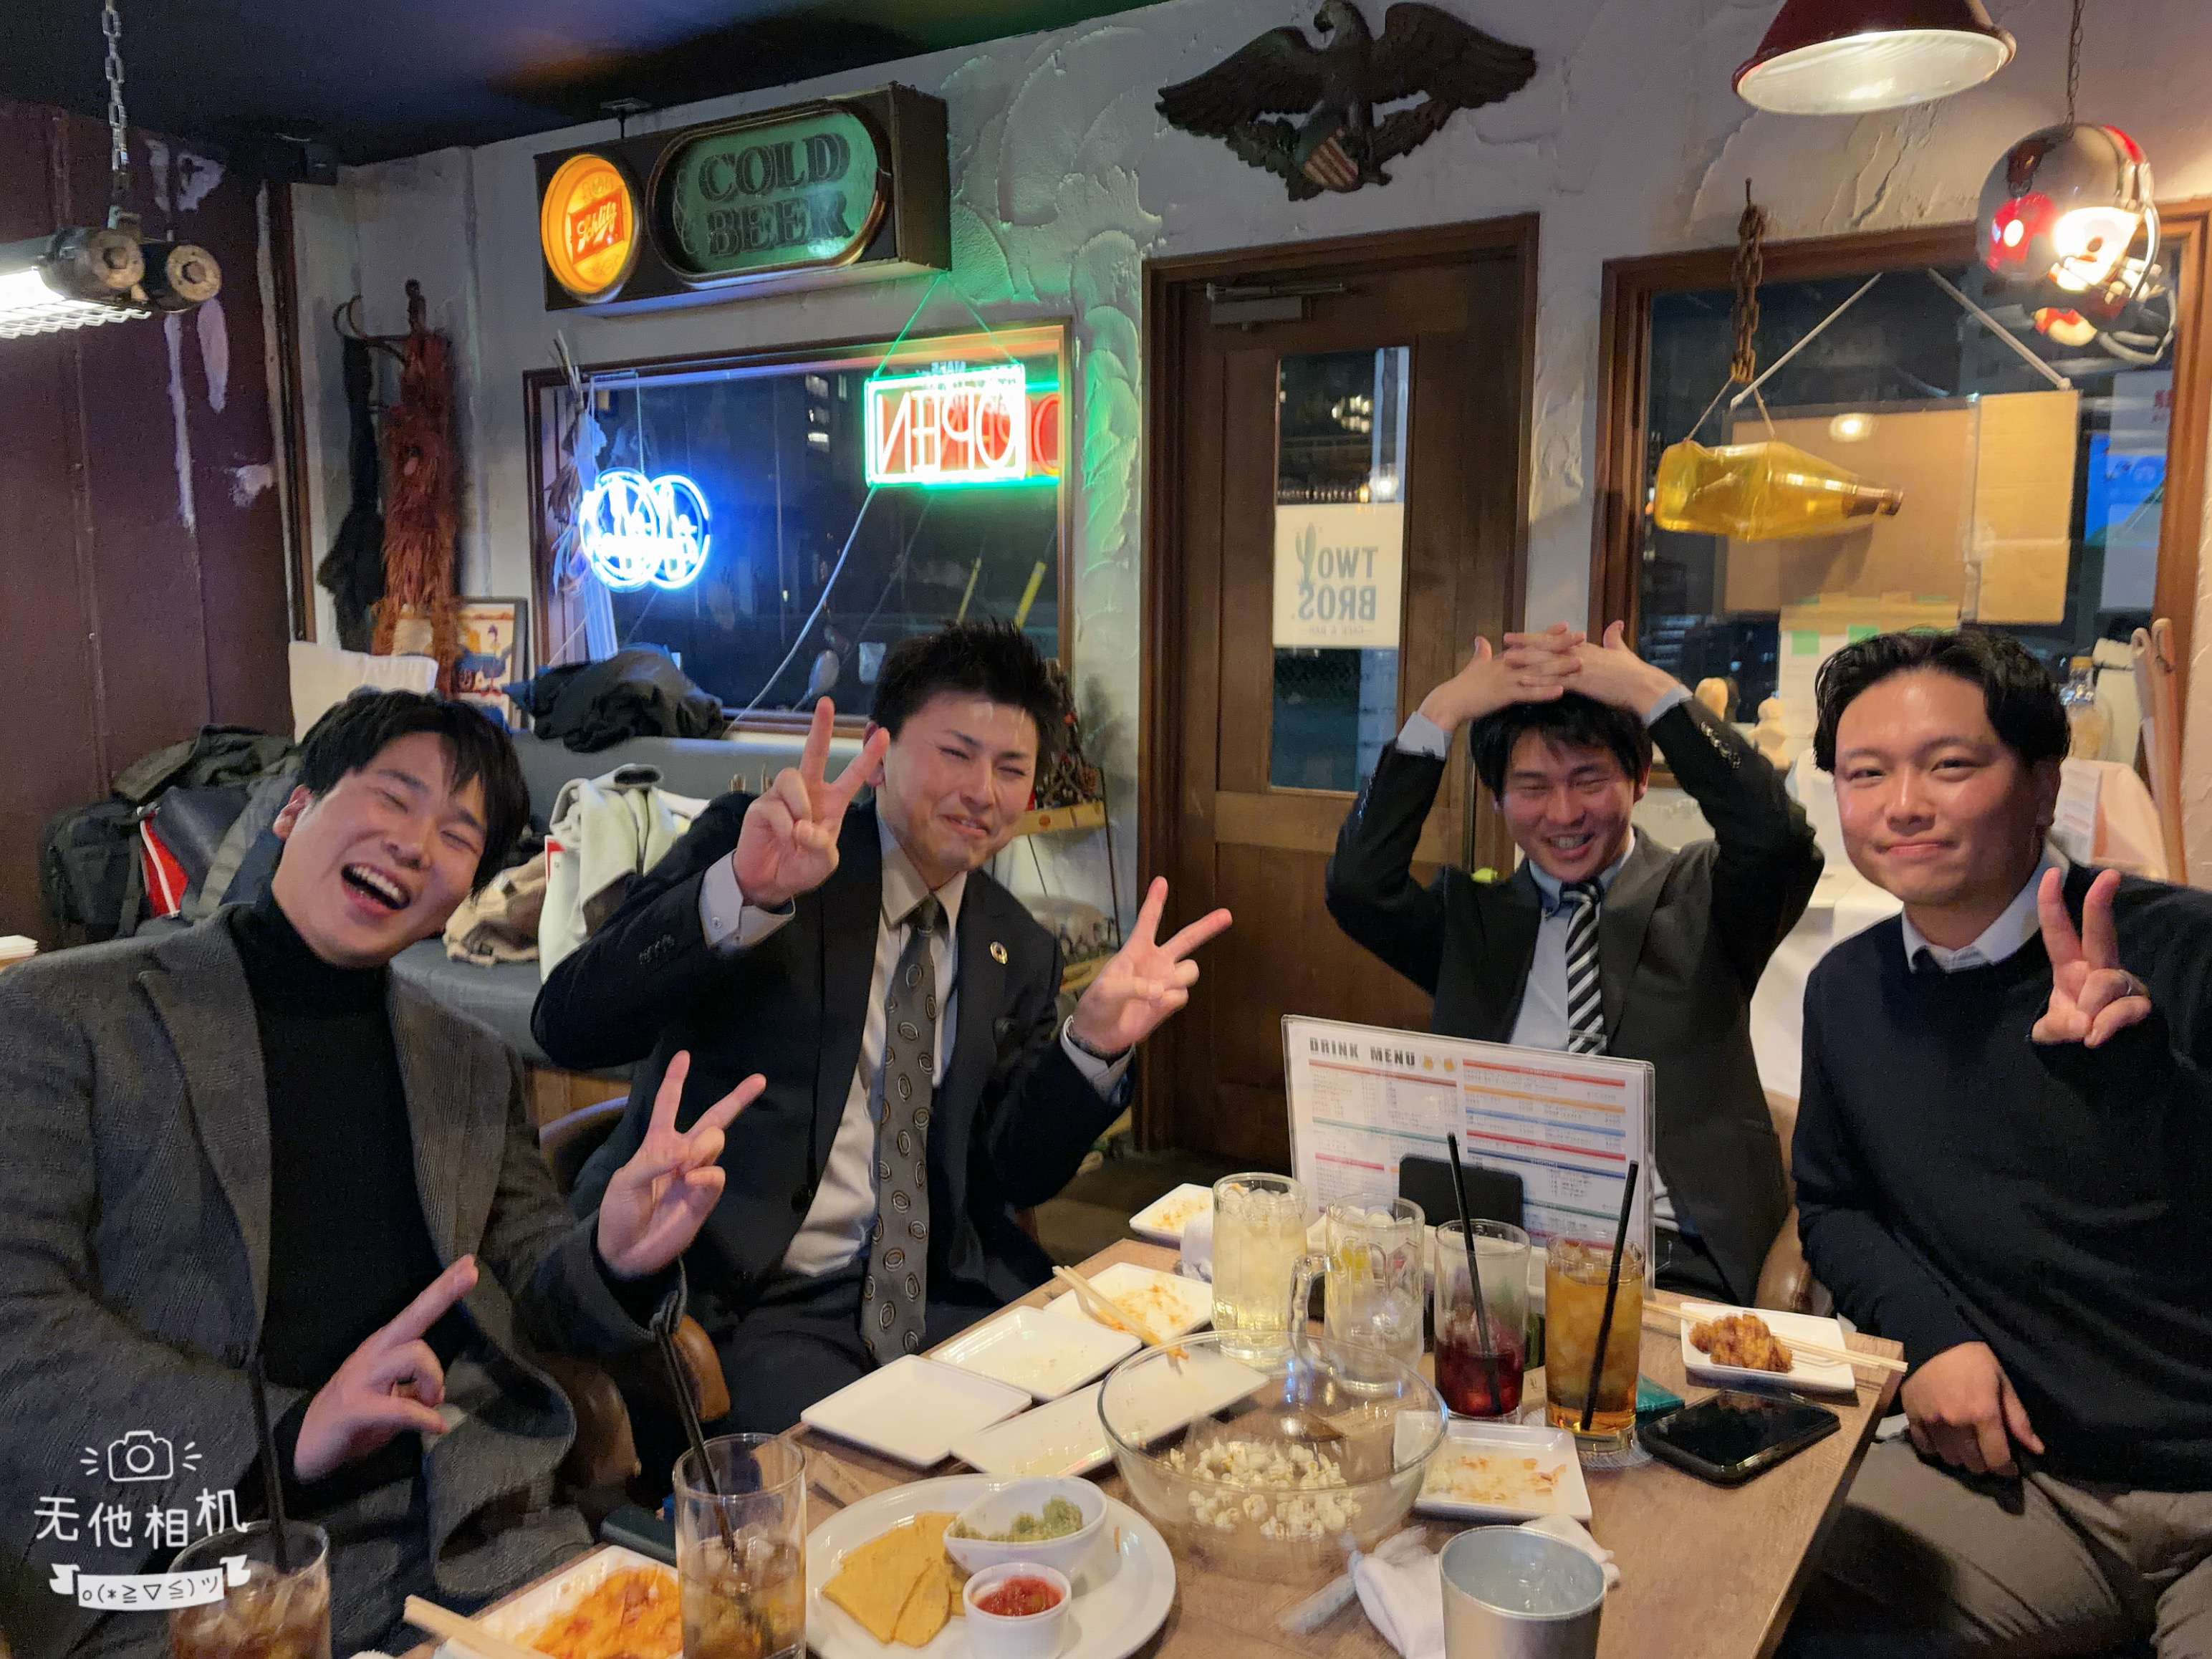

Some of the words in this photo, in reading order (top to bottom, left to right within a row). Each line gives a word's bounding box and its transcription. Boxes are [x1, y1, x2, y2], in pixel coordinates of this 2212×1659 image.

[698, 133, 851, 202] COLD
[576, 201, 617, 253] Schlitz
[706, 191, 855, 256] BEER
[1309, 1037, 1359, 1059] DRINK
[1370, 1046, 1416, 1067] MENU
